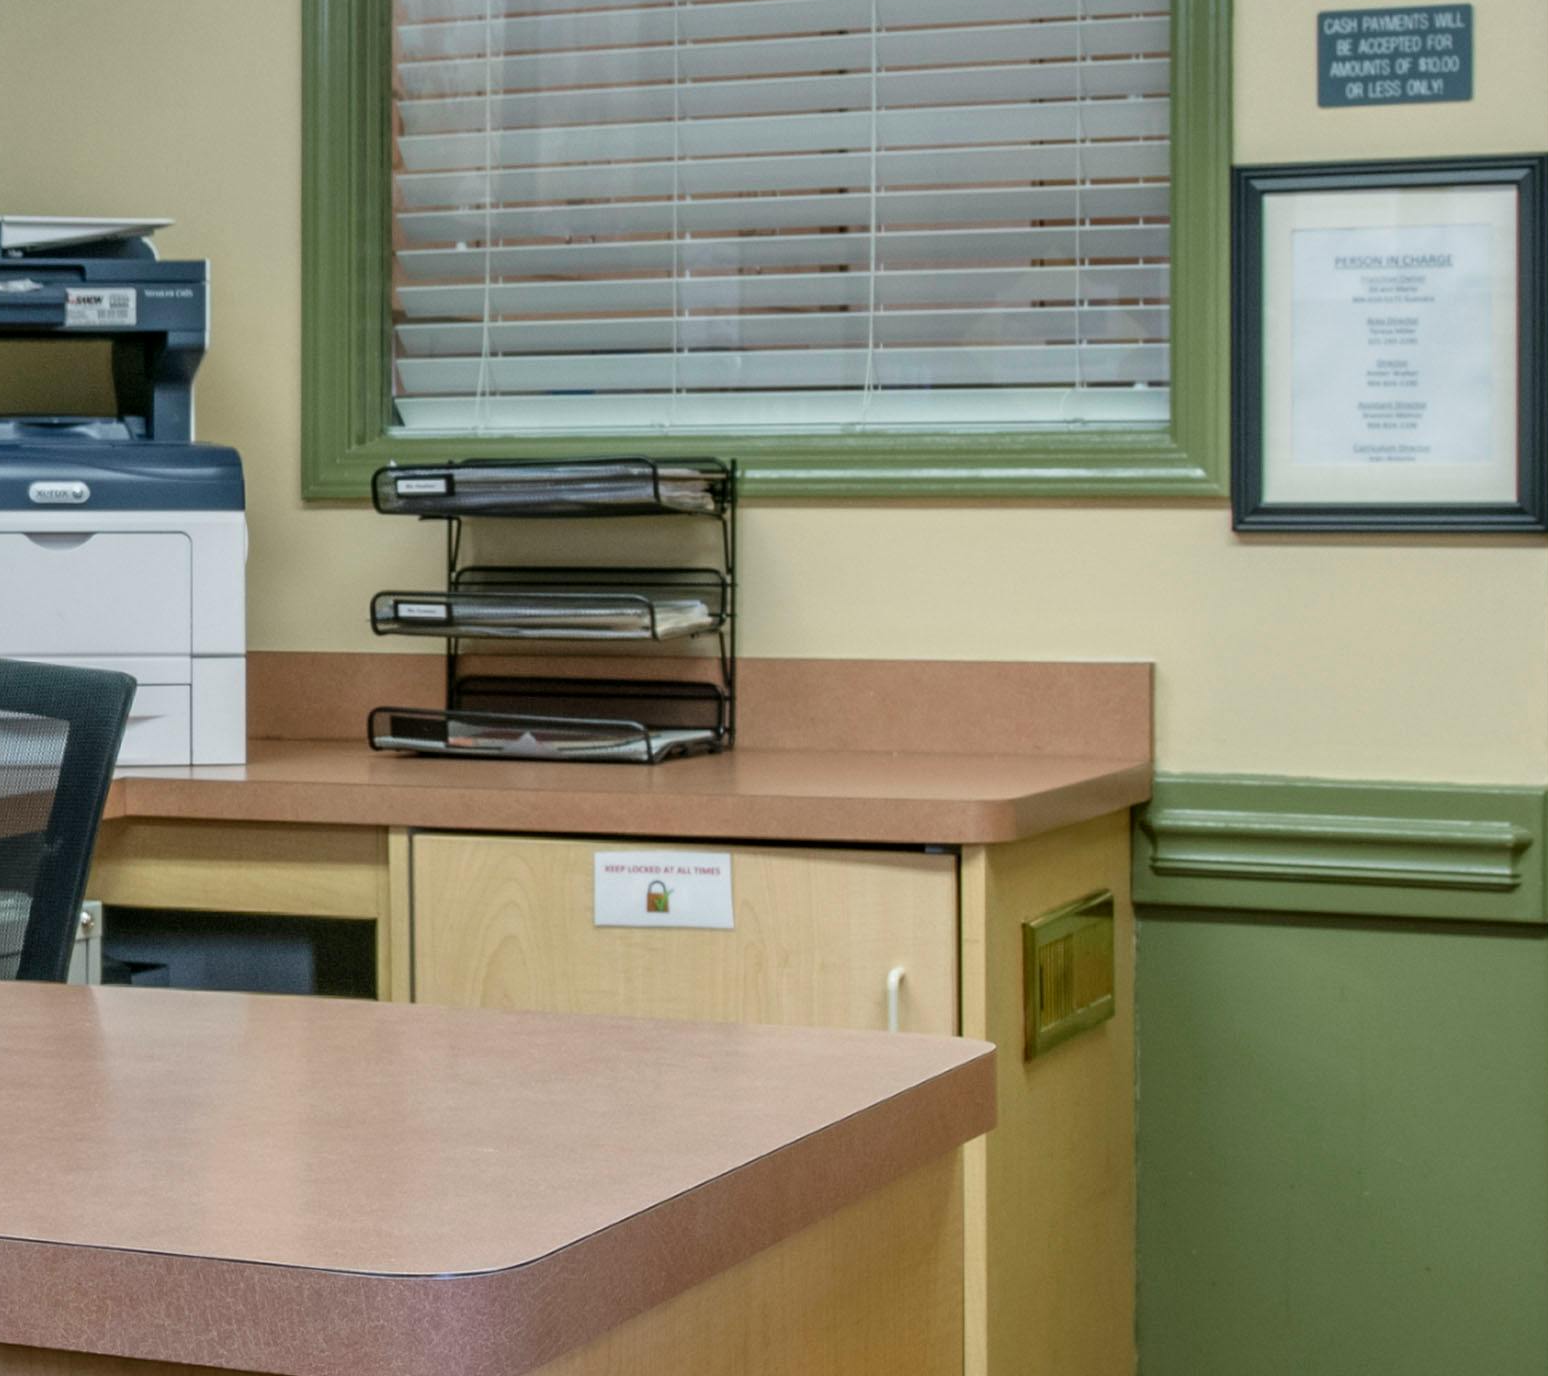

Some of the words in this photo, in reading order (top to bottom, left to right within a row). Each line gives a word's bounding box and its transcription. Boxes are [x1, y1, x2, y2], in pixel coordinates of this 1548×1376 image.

[1323, 17, 1358, 35] CASH
[1362, 13, 1429, 32] PAYMENTS
[1434, 11, 1465, 29] WILL
[1336, 39, 1352, 56] BE
[1358, 36, 1422, 54] ACCEPTED
[1426, 34, 1453, 51] FOR
[1329, 58, 1390, 78] AMOUNTS
[1394, 57, 1413, 74] OF
[1418, 56, 1460, 73] $10.00
[1345, 82, 1364, 100] OR
[1367, 79, 1402, 99] LESS
[1406, 78, 1445, 96] ONLY!
[1334, 255, 1383, 268] PERSON
[1386, 255, 1400, 267] IN
[1402, 253, 1453, 267] CHARGE
[604, 865, 625, 873] KEEP
[627, 865, 661, 874] LOCKED
[663, 866, 675, 874] AT
[677, 866, 691, 875] ALL
[694, 866, 721, 875] TIMES
